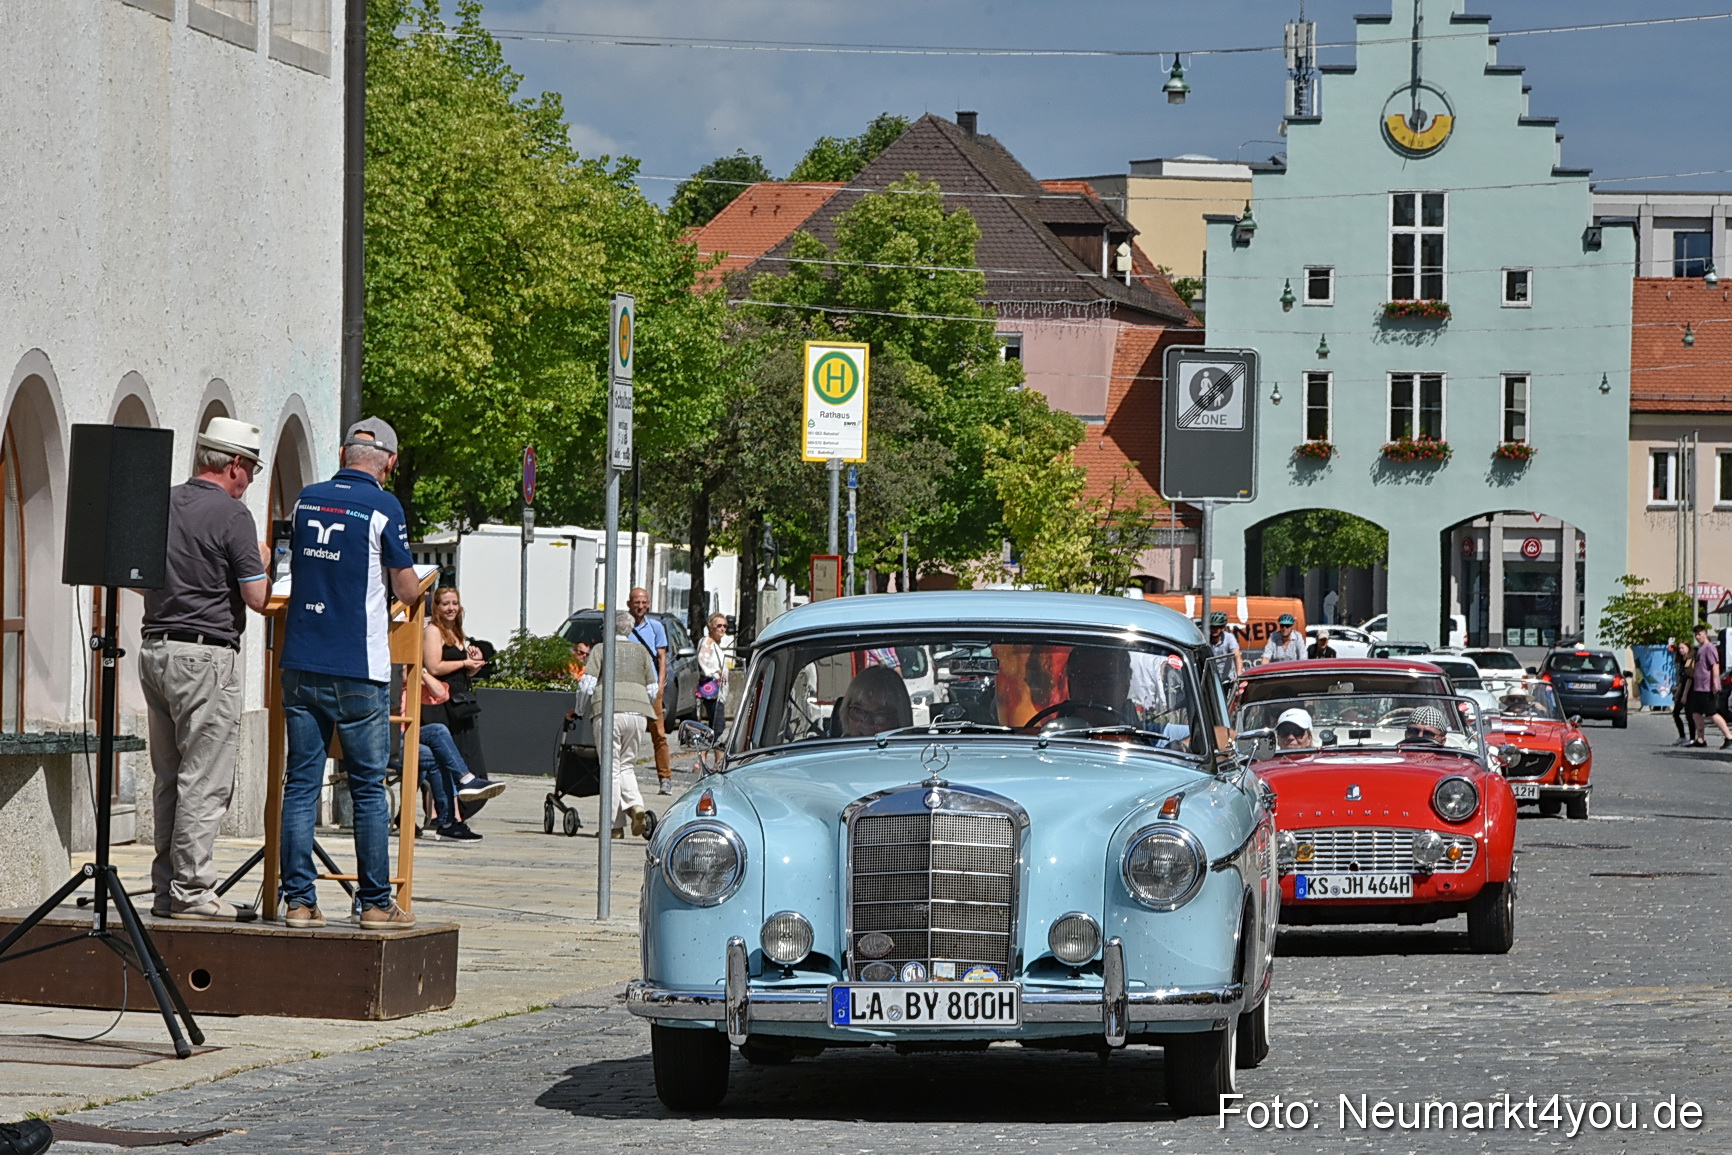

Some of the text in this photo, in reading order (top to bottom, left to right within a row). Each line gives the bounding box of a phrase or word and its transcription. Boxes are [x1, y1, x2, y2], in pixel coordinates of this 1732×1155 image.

[826, 363, 845, 393] H
[819, 410, 851, 419] Rathaus
[1193, 414, 1228, 425] ZONE
[345, 509, 369, 521] RACING
[303, 547, 341, 561] randstad
[305, 603, 315, 611] BT
[1298, 809, 1409, 818] TRIUMPH
[1307, 876, 1410, 896] KS JH 464H
[851, 991, 1014, 1020] LA BY 800H
